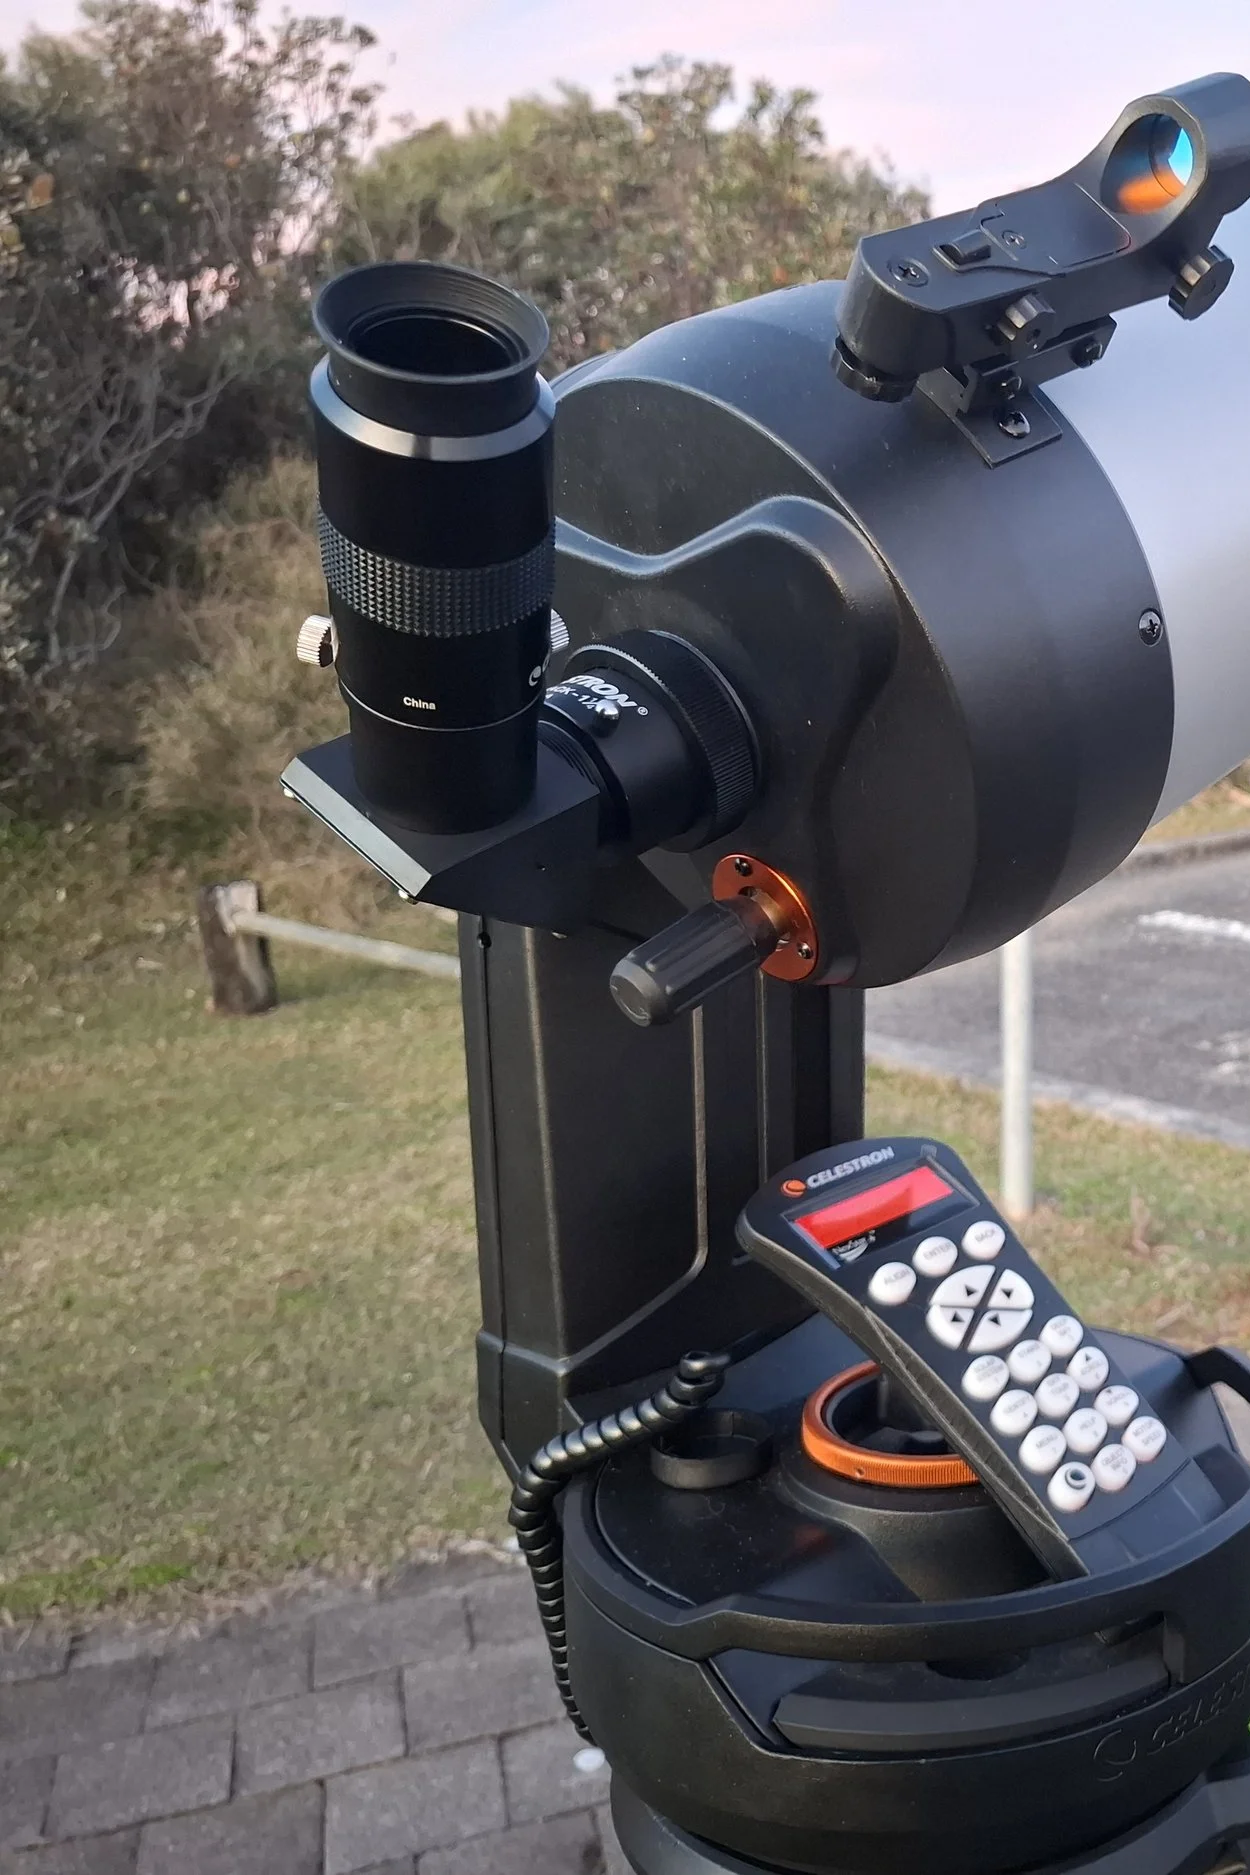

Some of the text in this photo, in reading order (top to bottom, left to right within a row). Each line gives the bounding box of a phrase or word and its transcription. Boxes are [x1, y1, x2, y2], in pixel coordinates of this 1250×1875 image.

[402, 696, 437, 711] China
[807, 1146, 895, 1188] CELESTRON
[974, 1228, 997, 1243] BACK
[922, 1241, 953, 1260] ENTER
